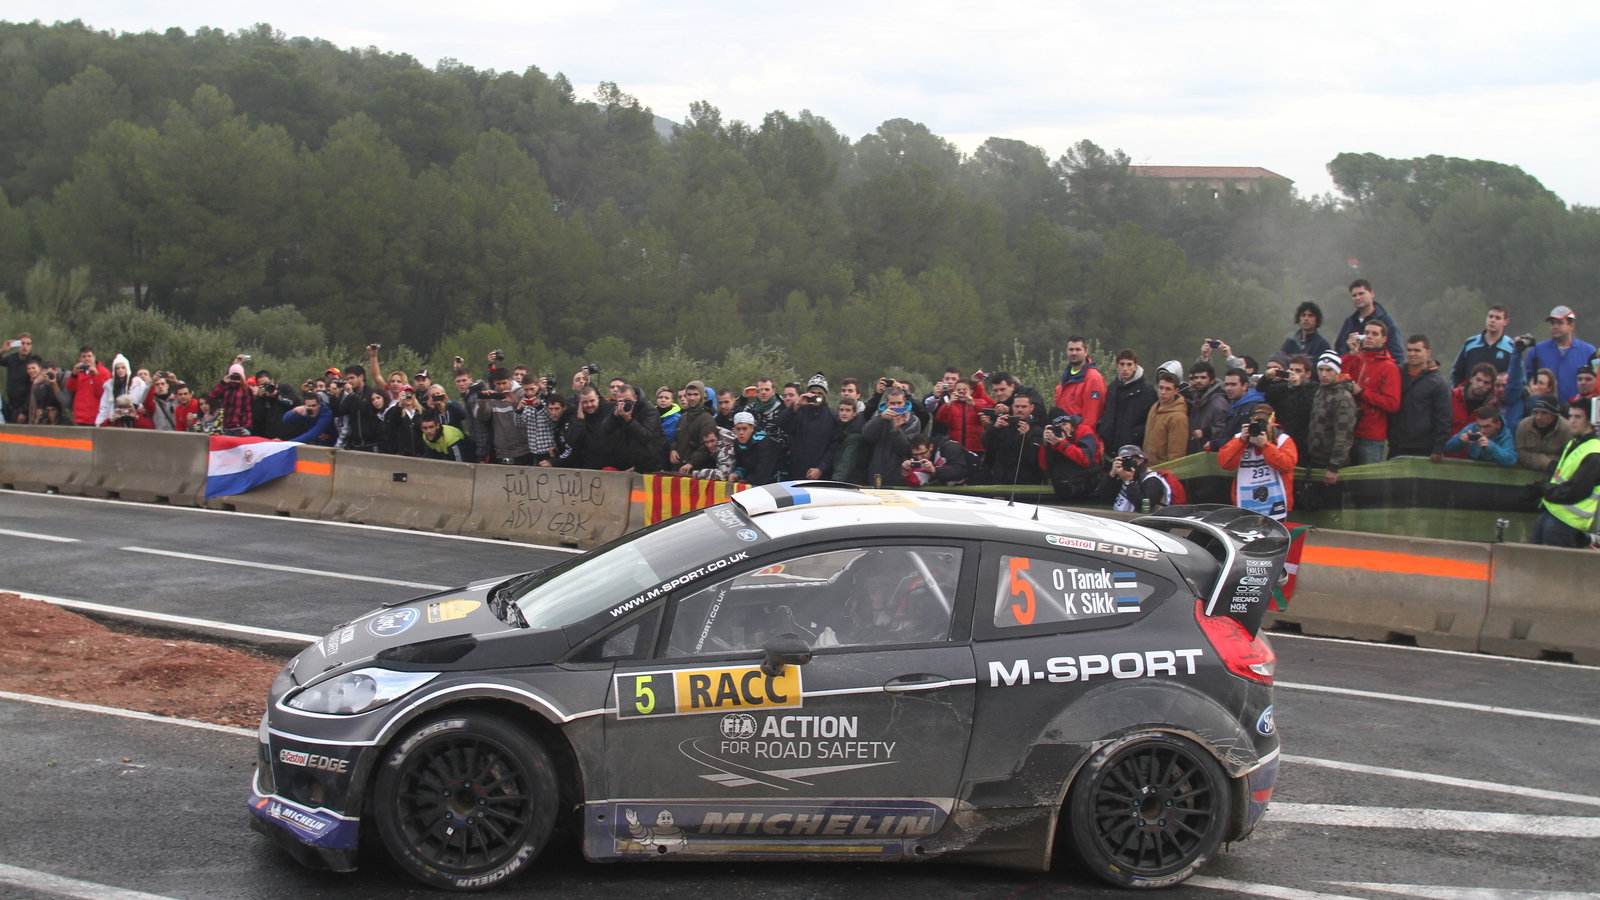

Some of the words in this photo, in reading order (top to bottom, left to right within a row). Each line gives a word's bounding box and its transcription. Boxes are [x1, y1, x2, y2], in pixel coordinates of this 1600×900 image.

[1058, 537, 1092, 549] Castrol
[1096, 542, 1159, 562] EDGE
[609, 550, 750, 618] WWW.M-SPORT.CO.UK
[1053, 568, 1064, 591] O
[1067, 567, 1112, 590] Tanak
[1009, 557, 1036, 626] 5
[1065, 592, 1077, 615] K
[1081, 591, 1115, 614] Sikk
[1230, 603, 1247, 611] NGK
[988, 648, 1203, 688] M-SPORT
[634, 675, 656, 715] 5
[688, 670, 788, 709] RACC
[760, 716, 858, 738] ACTION
[720, 741, 750, 754] FOR
[754, 742, 811, 759] ROAD
[817, 741, 896, 759] SAFETY
[285, 751, 307, 764] Castrol
[307, 754, 351, 774] EDGE
[282, 808, 326, 831] MICHELIN
[697, 812, 931, 836] MICHELIN
